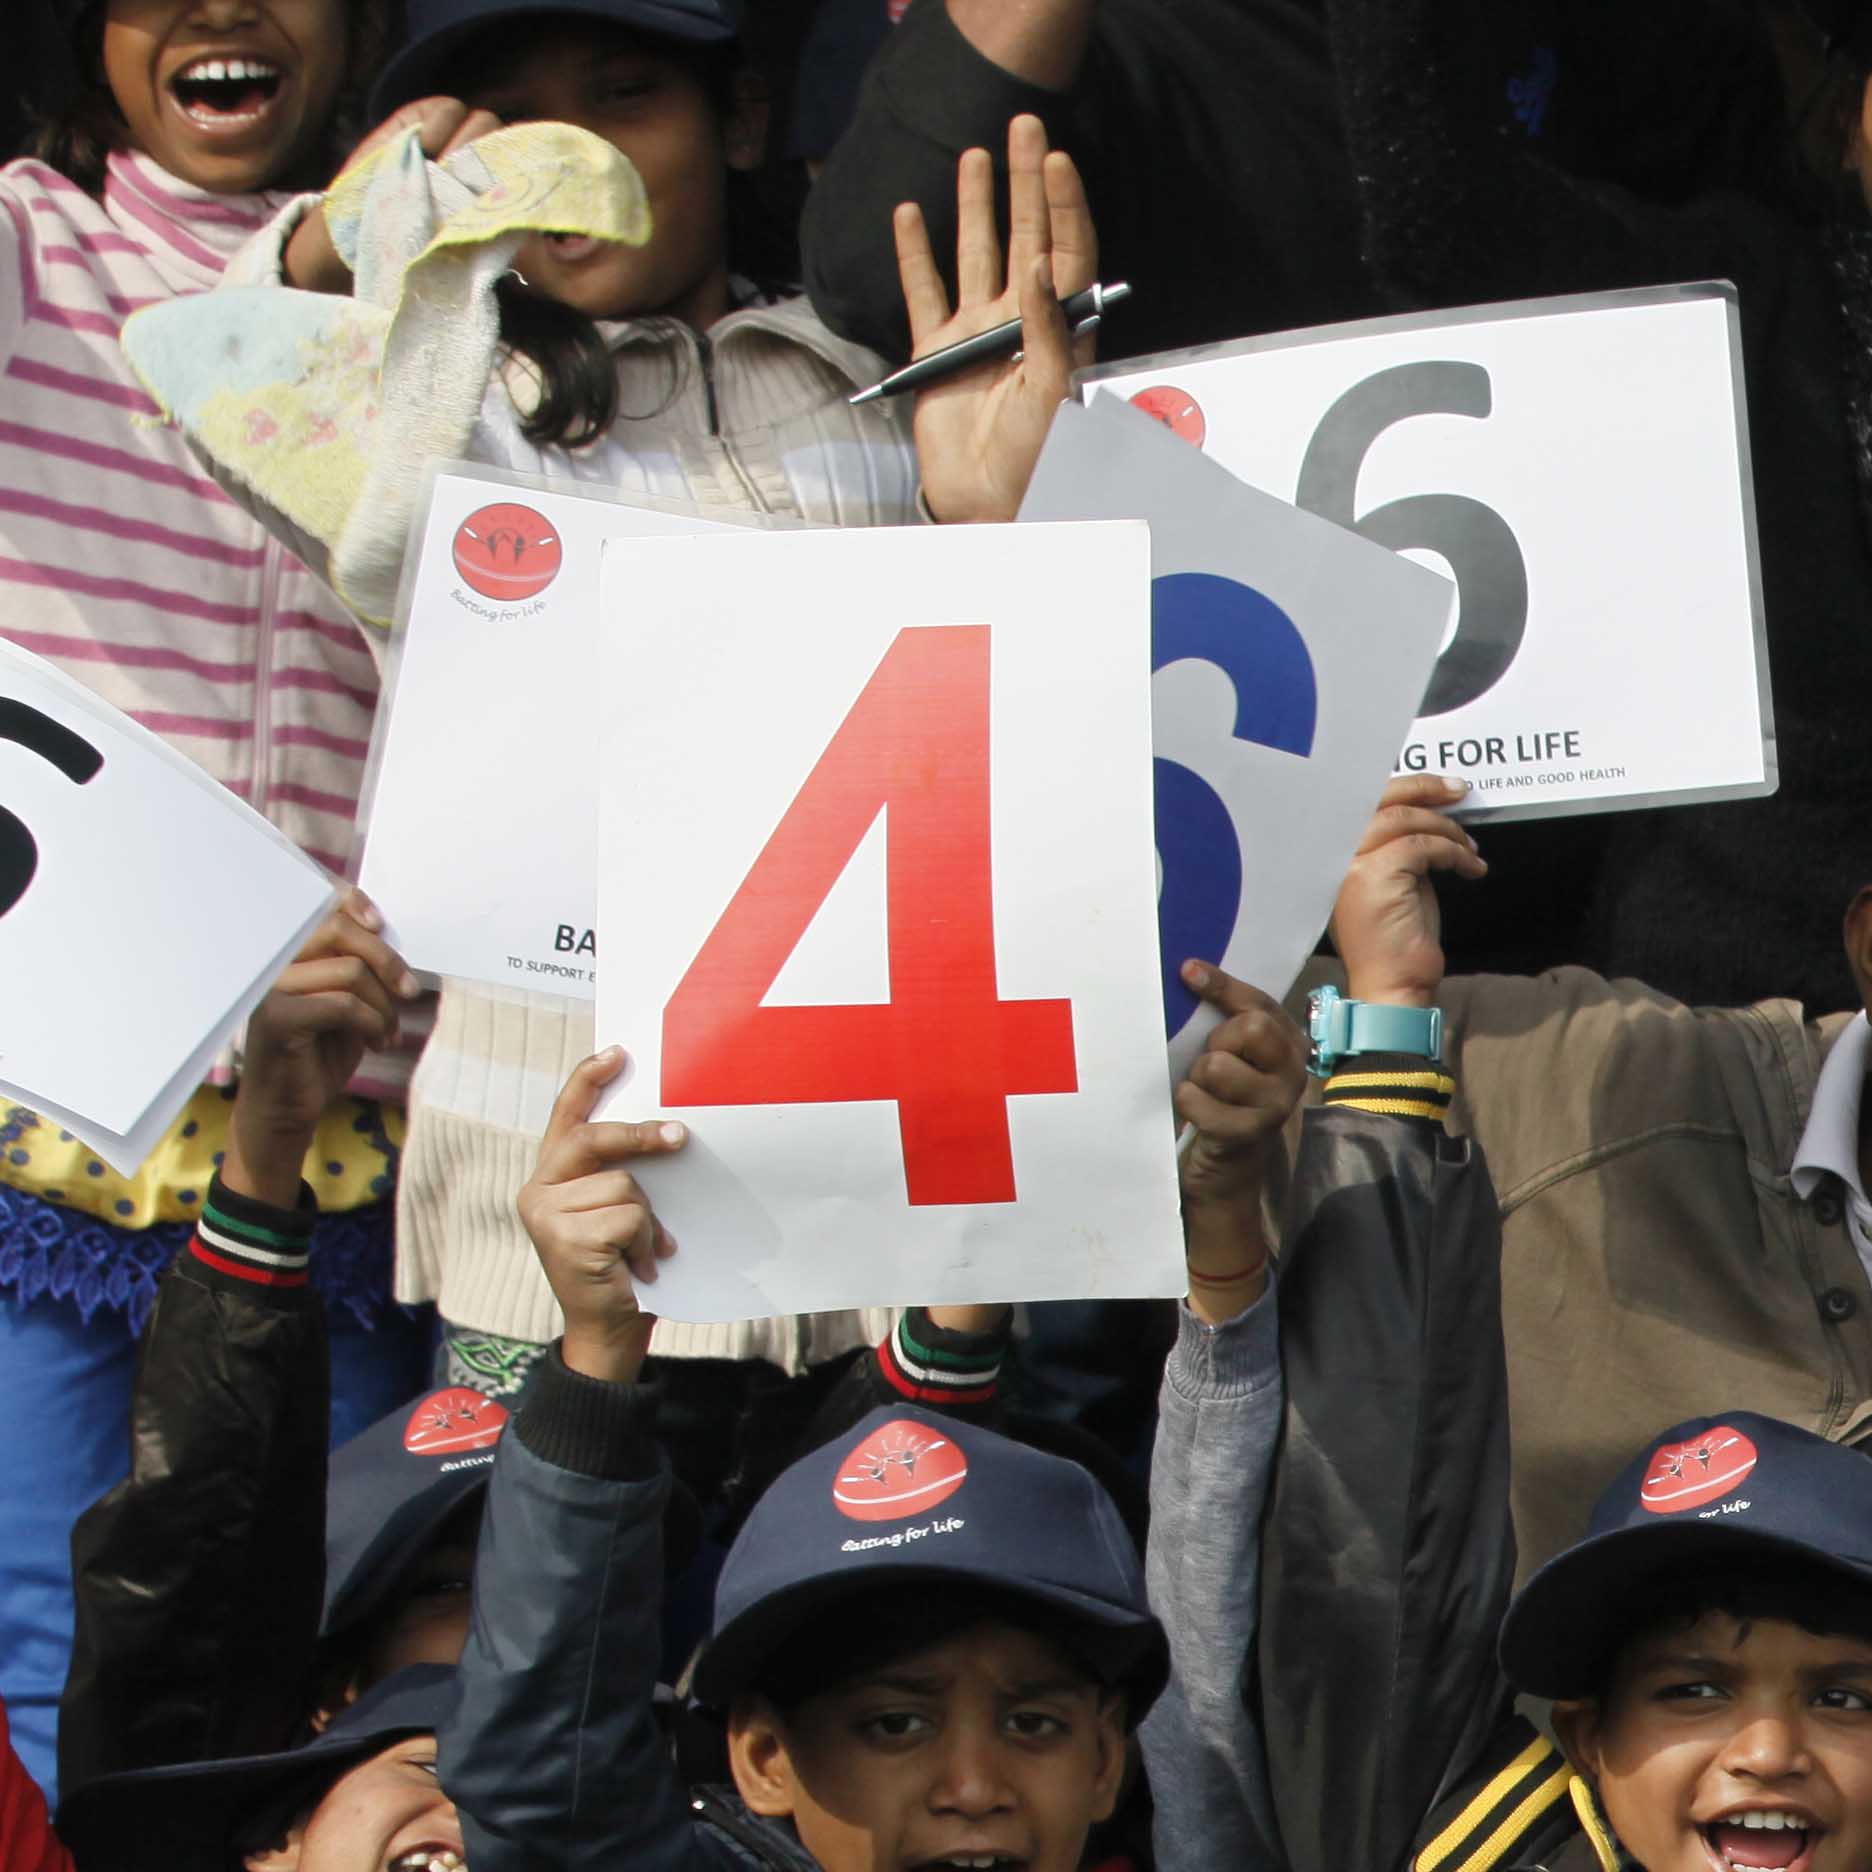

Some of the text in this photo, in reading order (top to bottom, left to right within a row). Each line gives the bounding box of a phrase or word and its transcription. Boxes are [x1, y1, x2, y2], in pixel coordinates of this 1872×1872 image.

[1295, 360, 1529, 719] 6
[1392, 730, 1581, 773] G FOR LIFE
[1479, 778, 1503, 791] LIFE
[1506, 776, 1533, 789] AND
[1538, 772, 1575, 785] GOOD
[1580, 767, 1626, 781] HEALTH
[660, 624, 1079, 1207] 4
[507, 956, 523, 969] TO
[526, 960, 584, 980] SUPPORT
[841, 1516, 965, 1552] Batting for life
